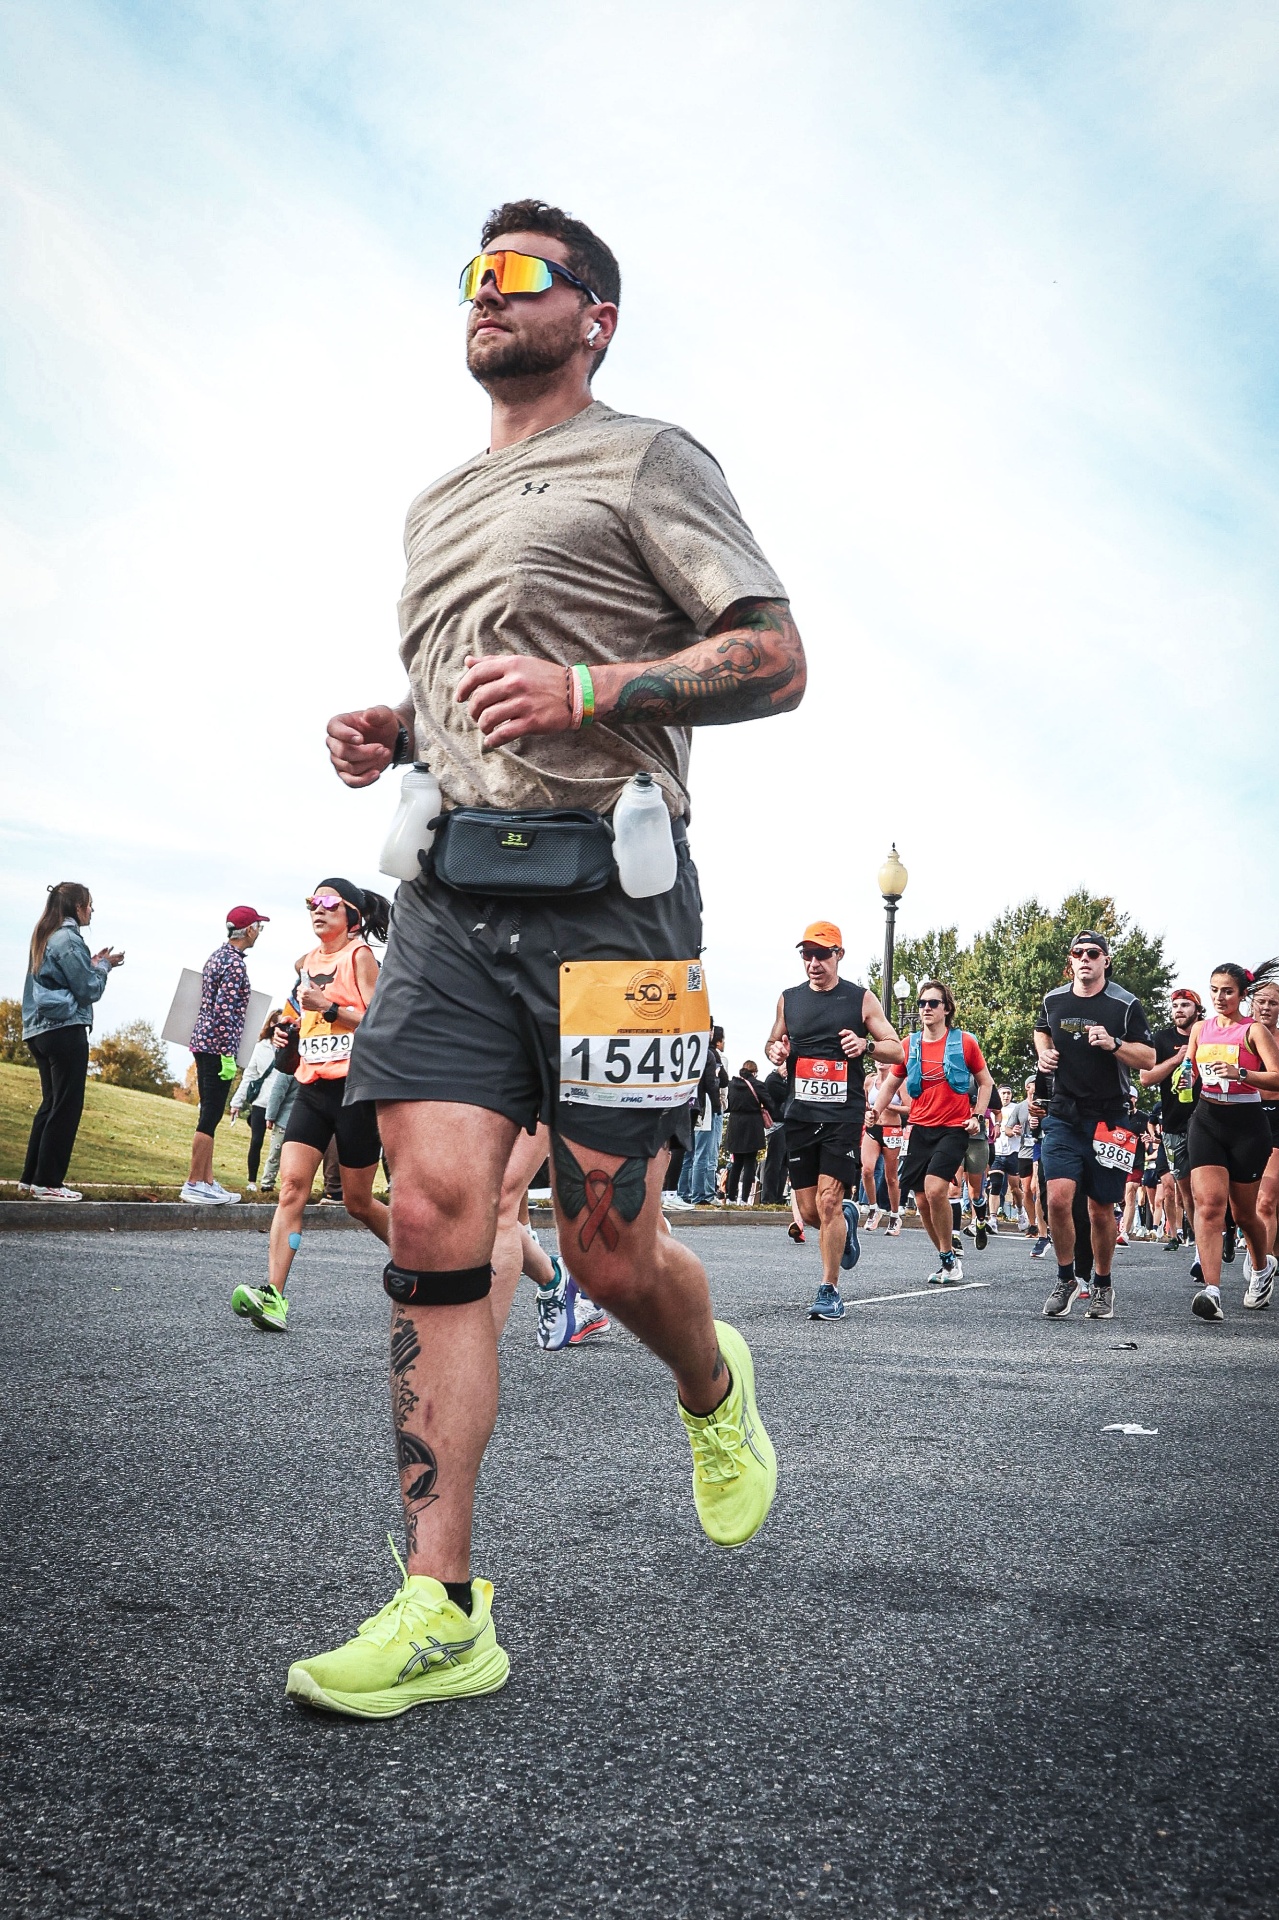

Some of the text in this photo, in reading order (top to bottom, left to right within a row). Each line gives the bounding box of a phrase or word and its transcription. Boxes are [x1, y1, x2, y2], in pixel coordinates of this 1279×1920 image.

[302, 1035, 350, 1054] 15529
[571, 1035, 701, 1083] 15492
[801, 1080, 839, 1095] 7550
[1099, 1143, 1132, 1165] 3865
